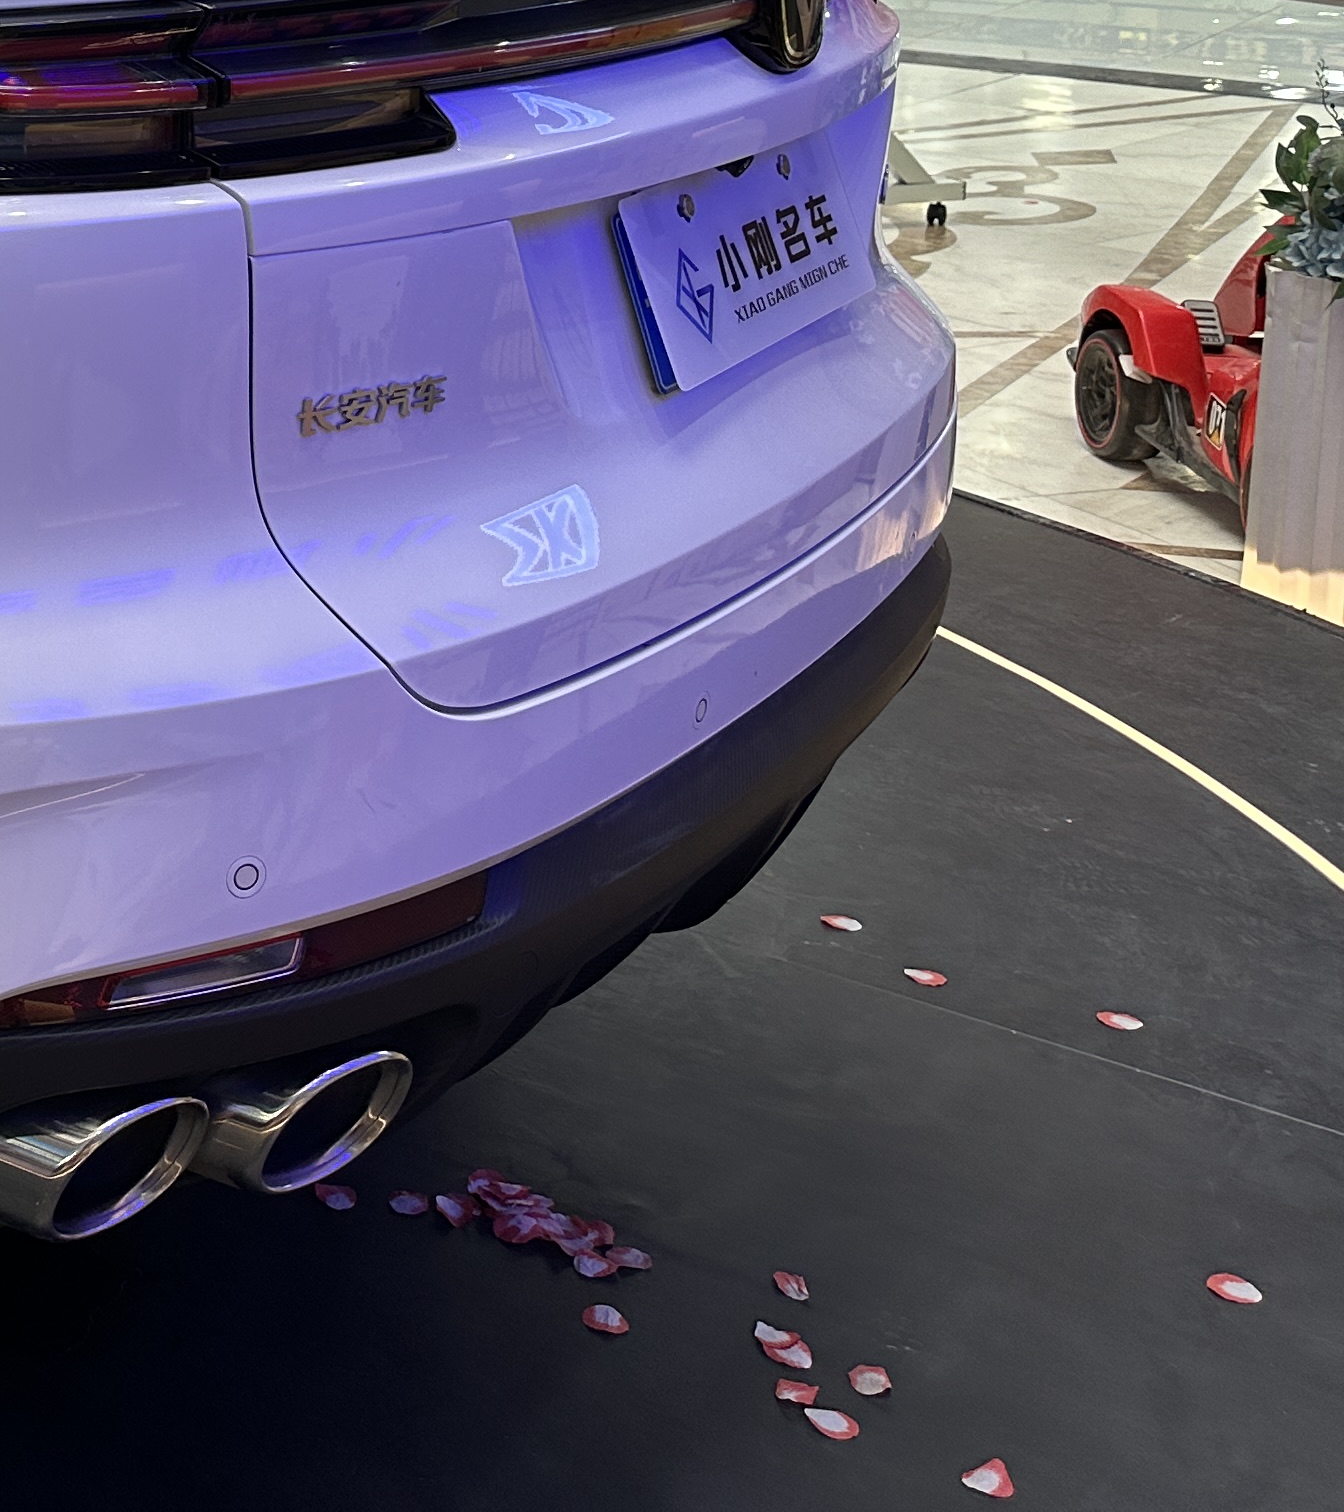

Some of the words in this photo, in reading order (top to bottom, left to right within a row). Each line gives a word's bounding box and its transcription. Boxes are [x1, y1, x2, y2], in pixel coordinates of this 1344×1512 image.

[716, 194, 839, 293] 小刚名车
[734, 296, 767, 324] XIAO
[766, 280, 800, 307] GANG
[828, 253, 851, 277] CHE
[296, 372, 449, 440] 长安汽车
